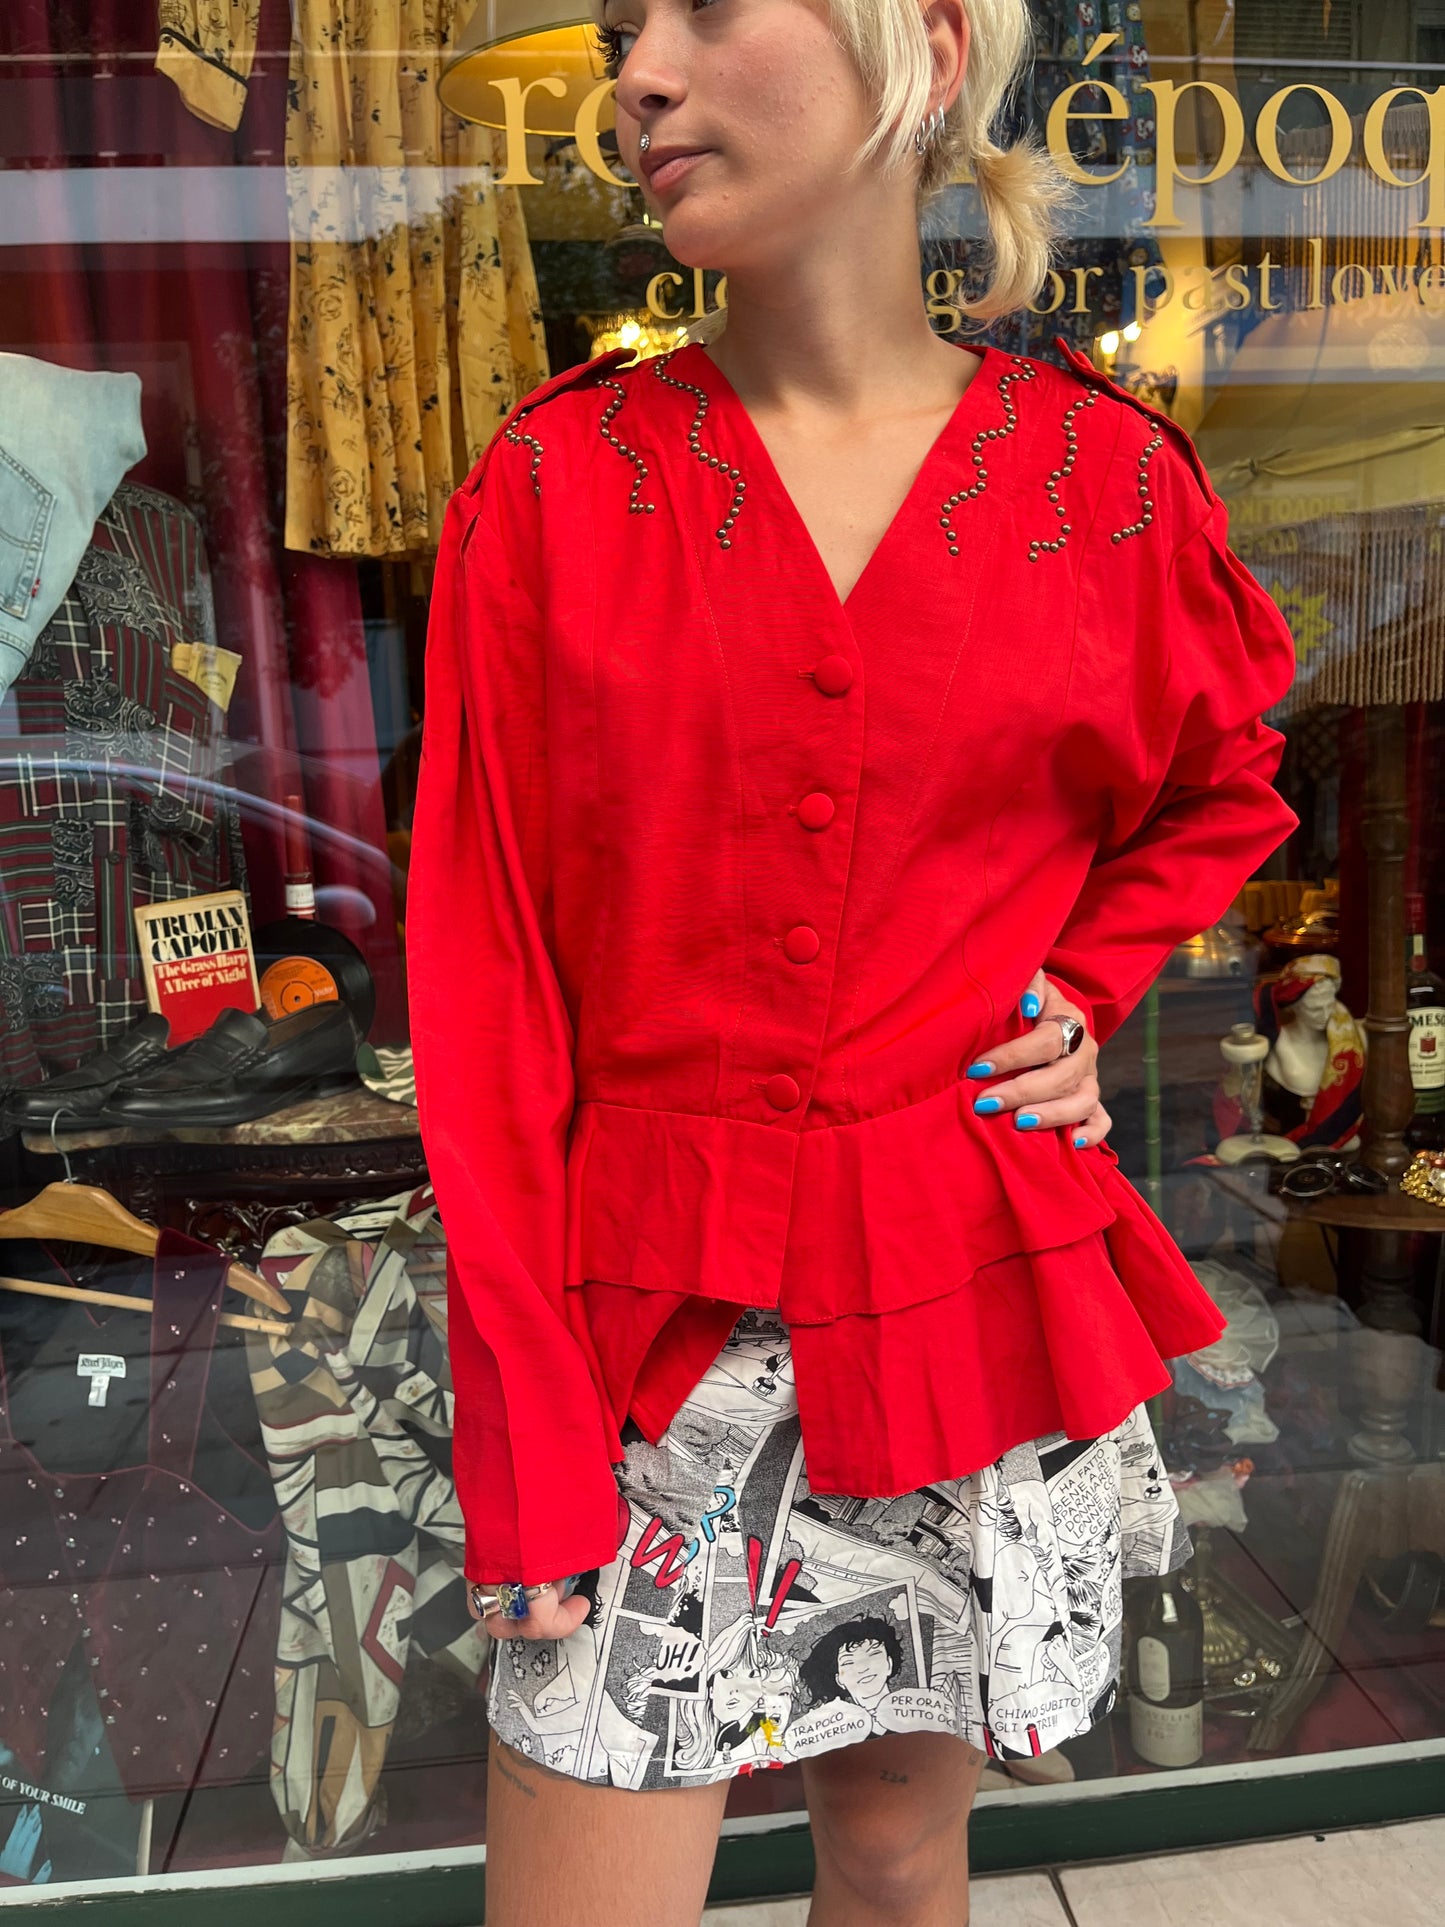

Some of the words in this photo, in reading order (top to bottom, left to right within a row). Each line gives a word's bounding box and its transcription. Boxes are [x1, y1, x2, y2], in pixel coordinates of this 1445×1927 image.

[1129, 251, 1282, 327] past
[145, 905, 243, 940] TRUMAN
[152, 927, 248, 962] CAPOTE
[156, 965, 181, 979] The
[181, 958, 217, 975] Grass
[216, 953, 248, 968] Harp
[163, 979, 174, 995] A
[173, 977, 201, 992] Tree
[202, 972, 214, 987] of
[216, 967, 247, 985] Night
[1058, 1478, 1076, 1494] HA
[1077, 1448, 1105, 1478] FATTO
[1051, 1481, 1088, 1515] BENE
[656, 1643, 699, 1672] UH!
[891, 1695, 913, 1705] PER
[916, 1697, 942, 1709] ORA
[893, 1708, 934, 1720] TUTTO
[1040, 1697, 1081, 1716] SUBITO
[792, 1725, 814, 1739] TRA
[815, 1711, 844, 1730] POCO
[793, 1719, 866, 1750] ARRIVEREMO
[994, 1721, 1018, 1733] GLI
[2, 1776, 18, 1791] OF
[19, 1782, 51, 1803] YOUR
[51, 1794, 87, 1815] SMILE
